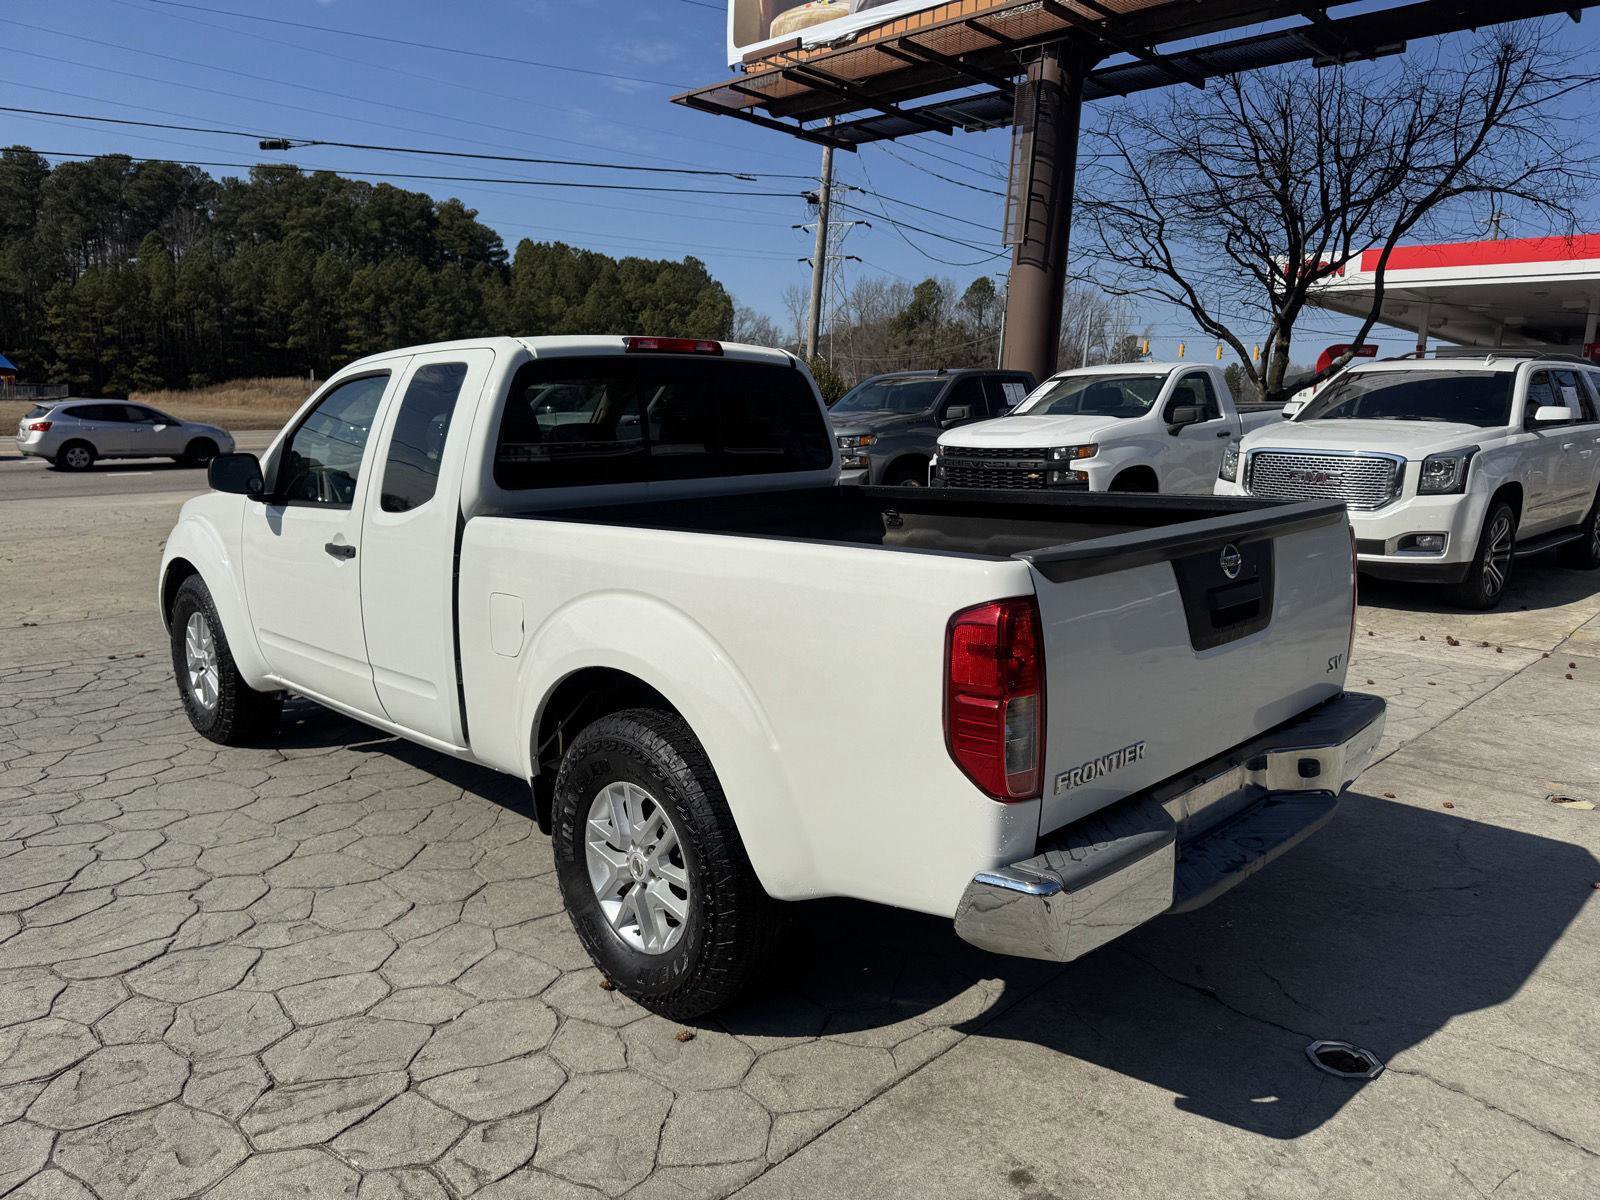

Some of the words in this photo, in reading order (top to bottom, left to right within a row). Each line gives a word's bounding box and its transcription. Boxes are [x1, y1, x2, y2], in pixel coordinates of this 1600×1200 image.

[1289, 469, 1344, 485] GMC
[1326, 653, 1343, 673] SV
[1054, 740, 1146, 795] FRONTIER
